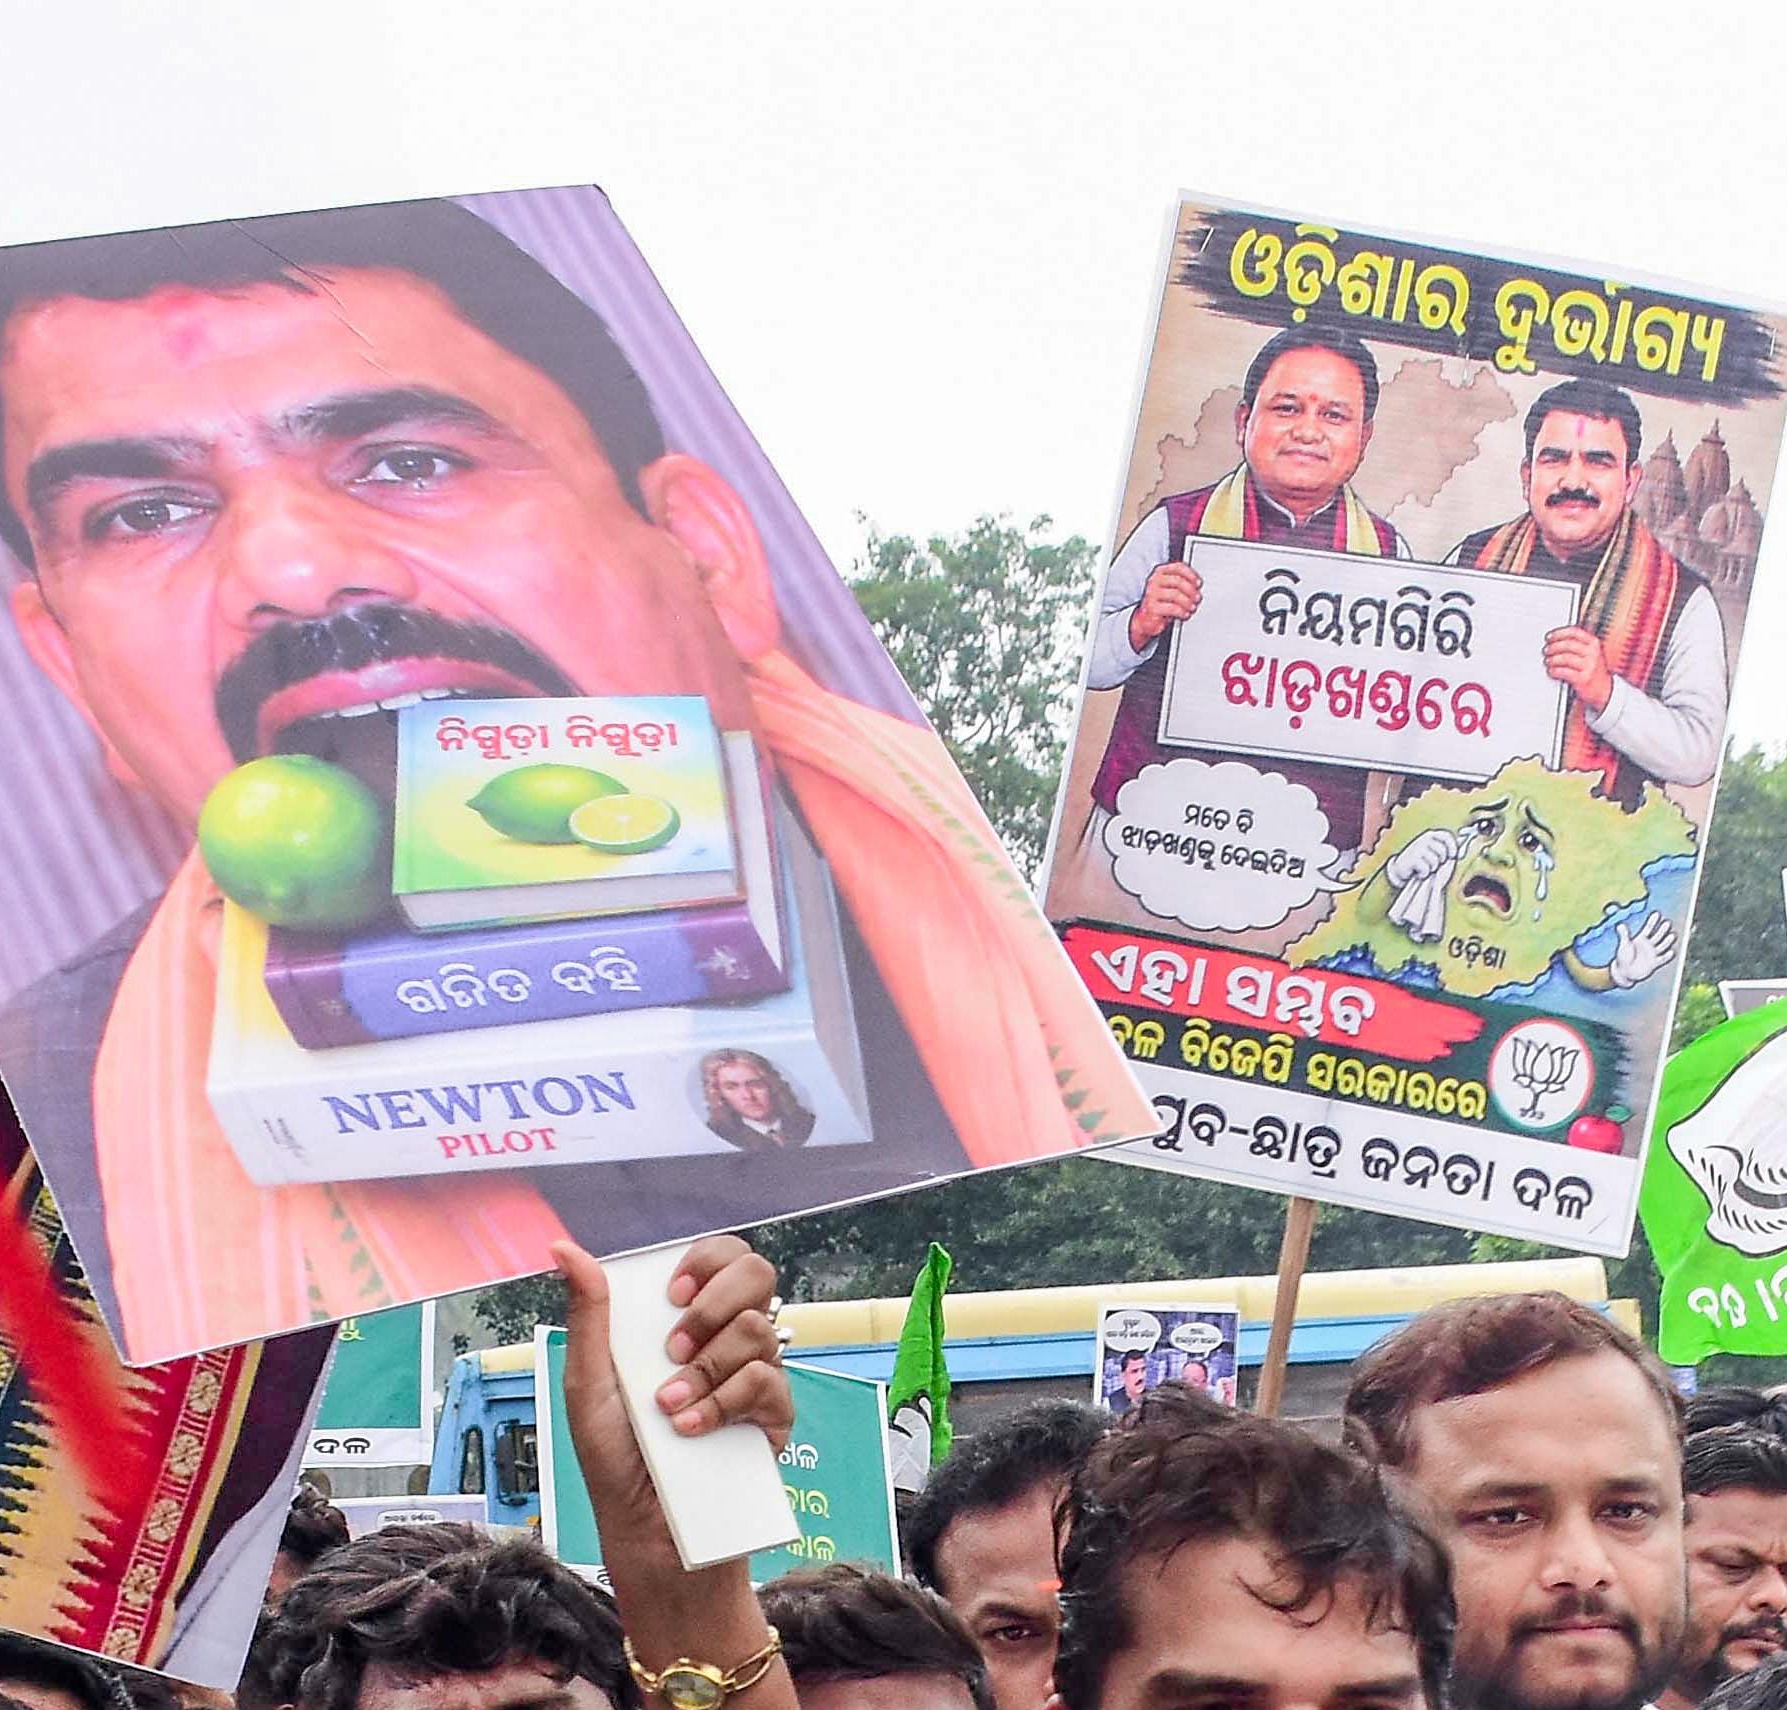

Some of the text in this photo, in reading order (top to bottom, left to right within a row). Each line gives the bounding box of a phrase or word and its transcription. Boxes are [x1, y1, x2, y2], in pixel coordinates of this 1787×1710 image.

[1229, 222, 1726, 381] ଓଡ଼ିଶାର ଦୁର୍ଭାଗ୍ୟ
[1259, 569, 1474, 660] ନିୟମଗିରି
[1221, 647, 1494, 738] ଝାଡ଼ଖଣ୍ଡରେ
[1090, 942, 1376, 1038] ଏହା ସମ୍ଭବ
[1448, 934, 1507, 970] ଓଡ଼ିଶା
[323, 1070, 637, 1134] NEWTON
[1180, 1017, 1294, 1083] ବିଜେପି
[1306, 1053, 1488, 1120] ସରକାରରେ
[438, 1128, 557, 1159] PILOT
[1361, 1136, 1496, 1201] ଜନତା
[1512, 1167, 1594, 1219] ଦଳ
[313, 1437, 370, 1454] ଦଳ
